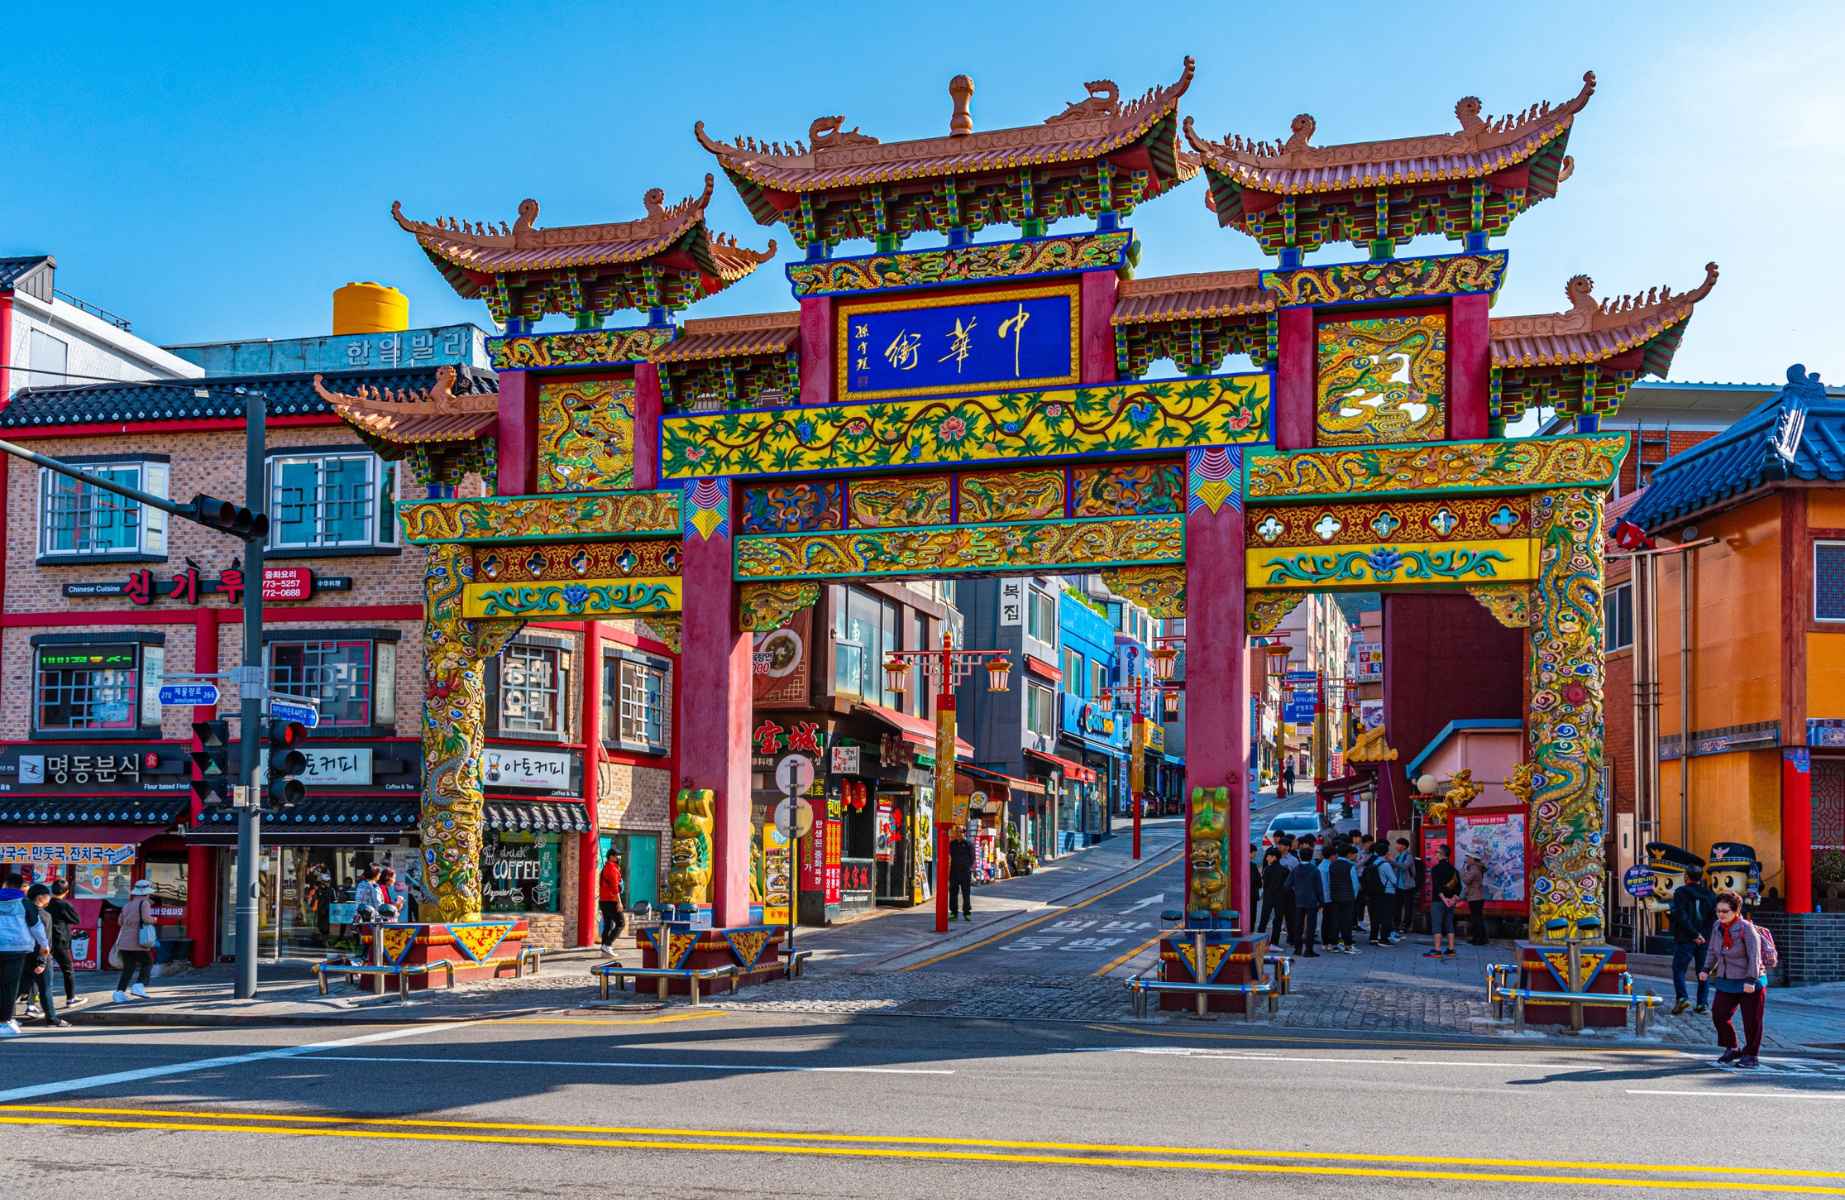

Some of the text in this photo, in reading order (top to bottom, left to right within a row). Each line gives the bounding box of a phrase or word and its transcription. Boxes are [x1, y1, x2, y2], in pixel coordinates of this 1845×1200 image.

[96, 584, 120, 592] Cuisine
[123, 568, 246, 604] 신기루
[47, 754, 140, 784] 명동분식
[304, 752, 358, 776] 토커피
[493, 860, 540, 880] COFFEE
